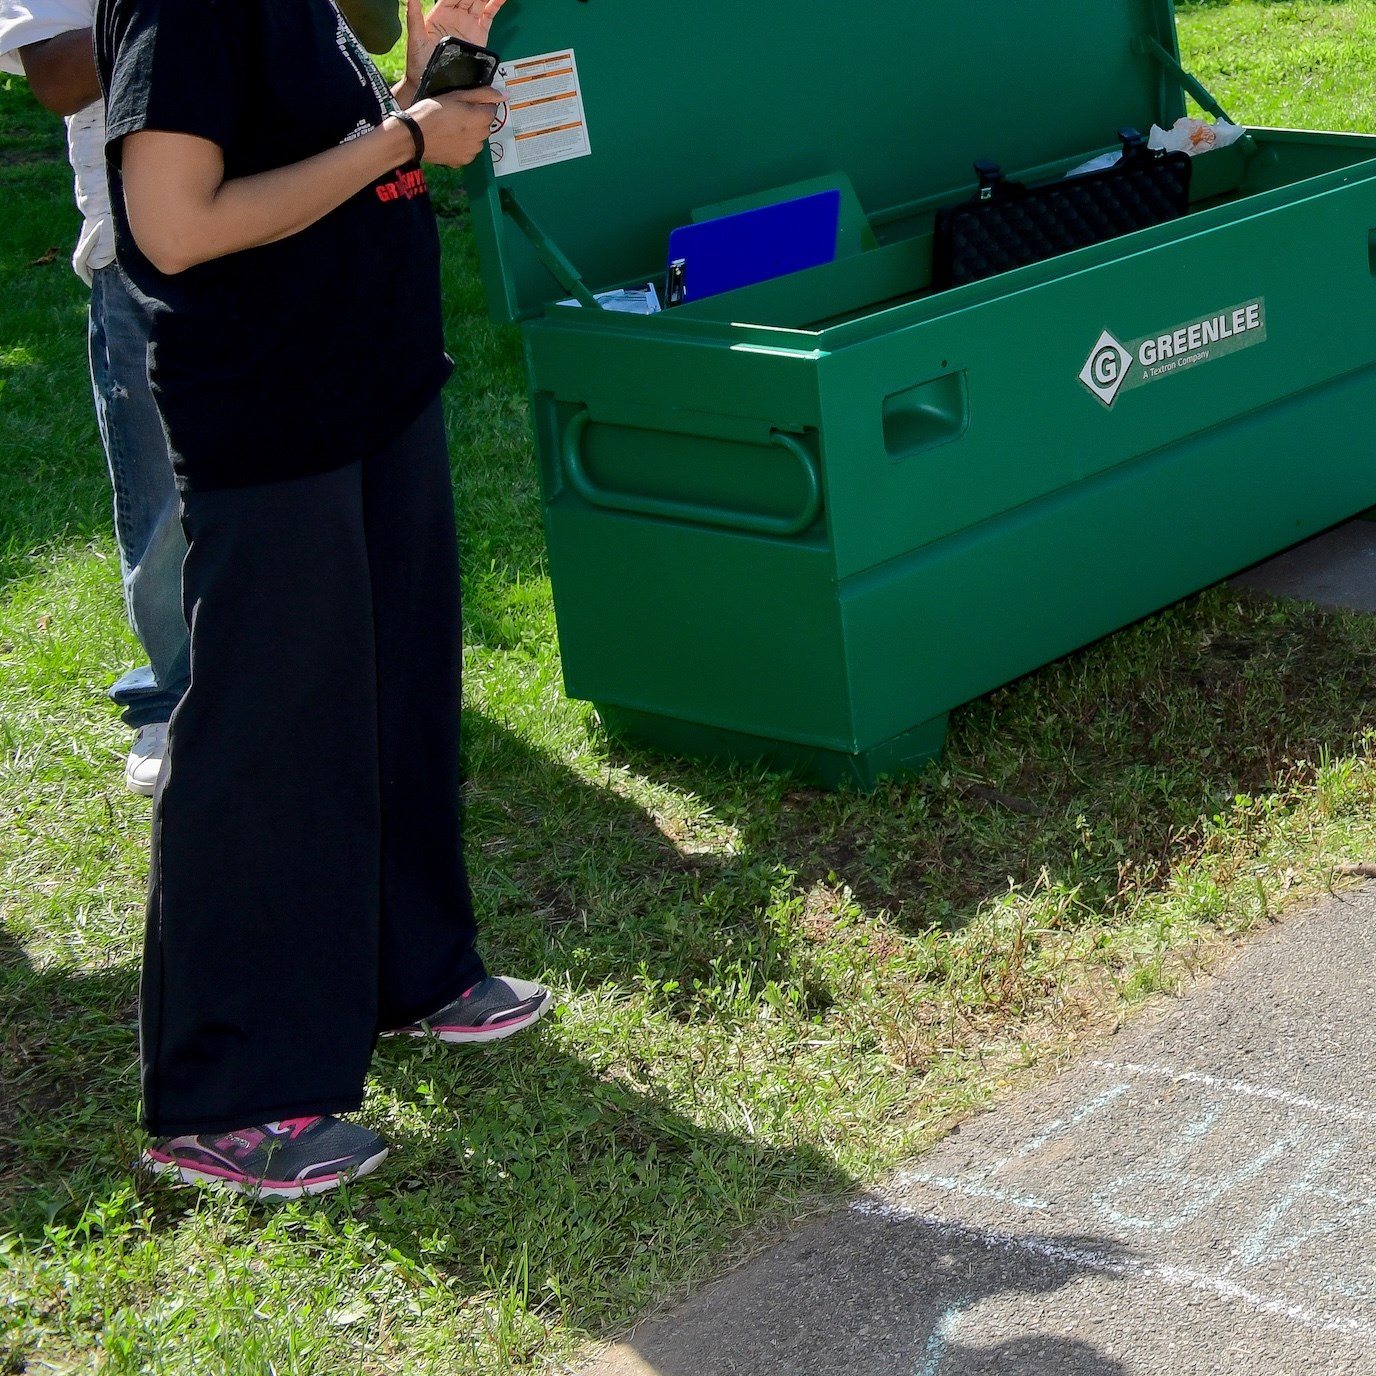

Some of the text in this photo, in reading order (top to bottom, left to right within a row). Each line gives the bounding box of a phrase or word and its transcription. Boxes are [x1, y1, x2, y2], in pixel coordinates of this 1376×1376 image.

[1138, 303, 1261, 367] GREENLEE
[1142, 350, 1210, 380] A Textron Company
